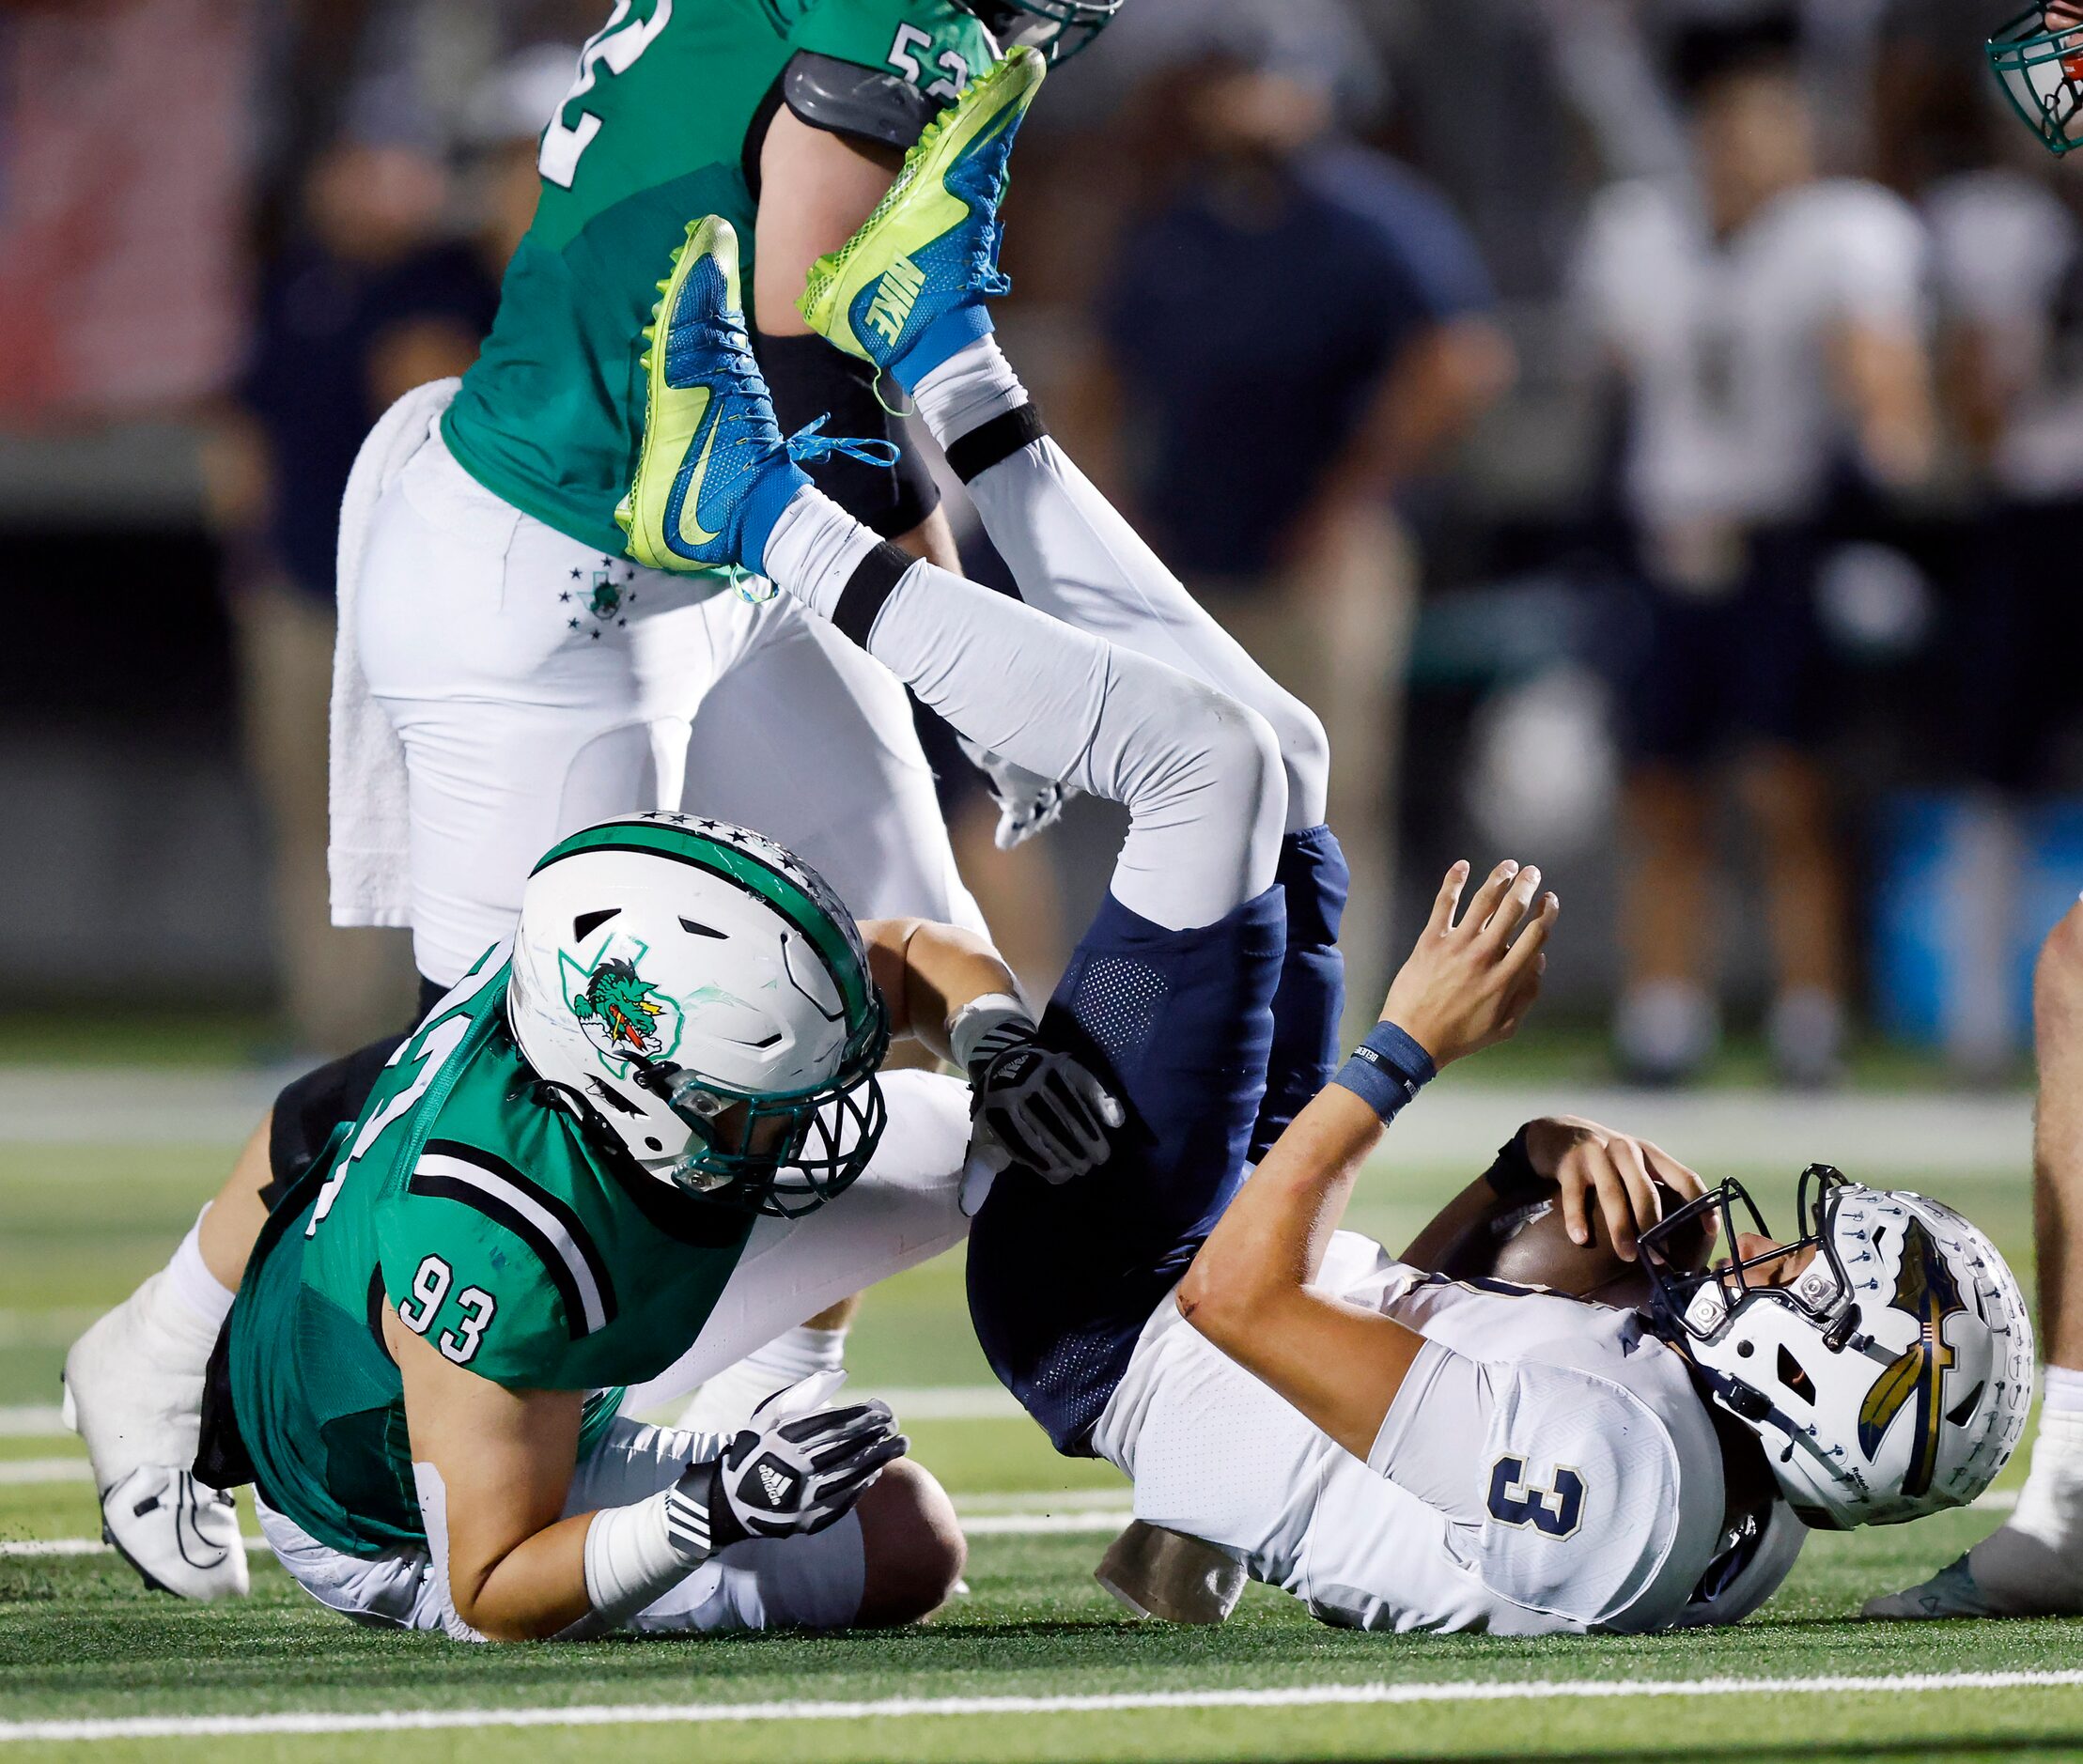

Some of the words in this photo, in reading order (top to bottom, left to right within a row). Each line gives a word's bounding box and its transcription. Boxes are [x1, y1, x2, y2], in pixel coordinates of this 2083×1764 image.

[886, 21, 970, 101] 52
[864, 246, 926, 348] NIKE
[398, 1253, 498, 1366] 93
[757, 1463, 782, 1506] adidas
[1486, 1452, 1589, 1542] 3
